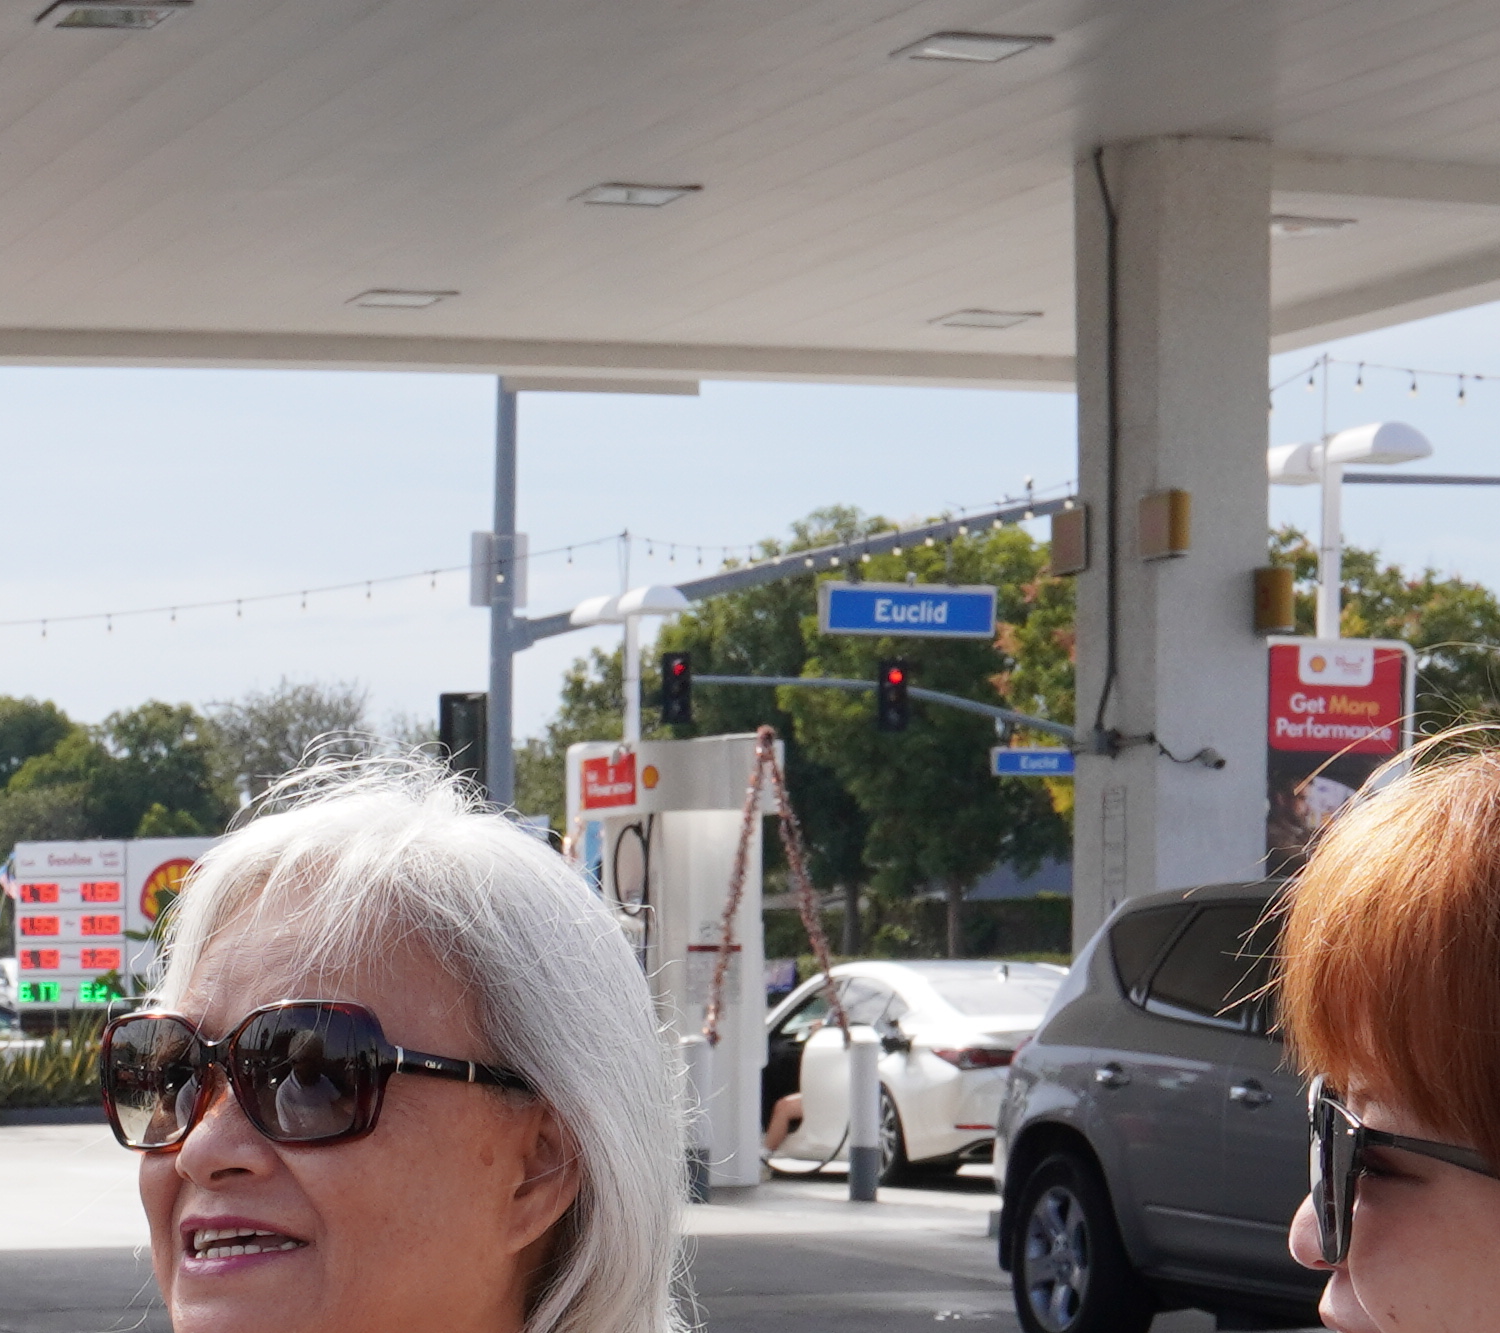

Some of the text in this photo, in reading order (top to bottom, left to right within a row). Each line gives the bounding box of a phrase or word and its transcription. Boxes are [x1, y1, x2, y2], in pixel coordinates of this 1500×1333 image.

[874, 599, 948, 624] Euclid
[1290, 692, 1380, 716] Get More
[1276, 717, 1393, 740] Performance
